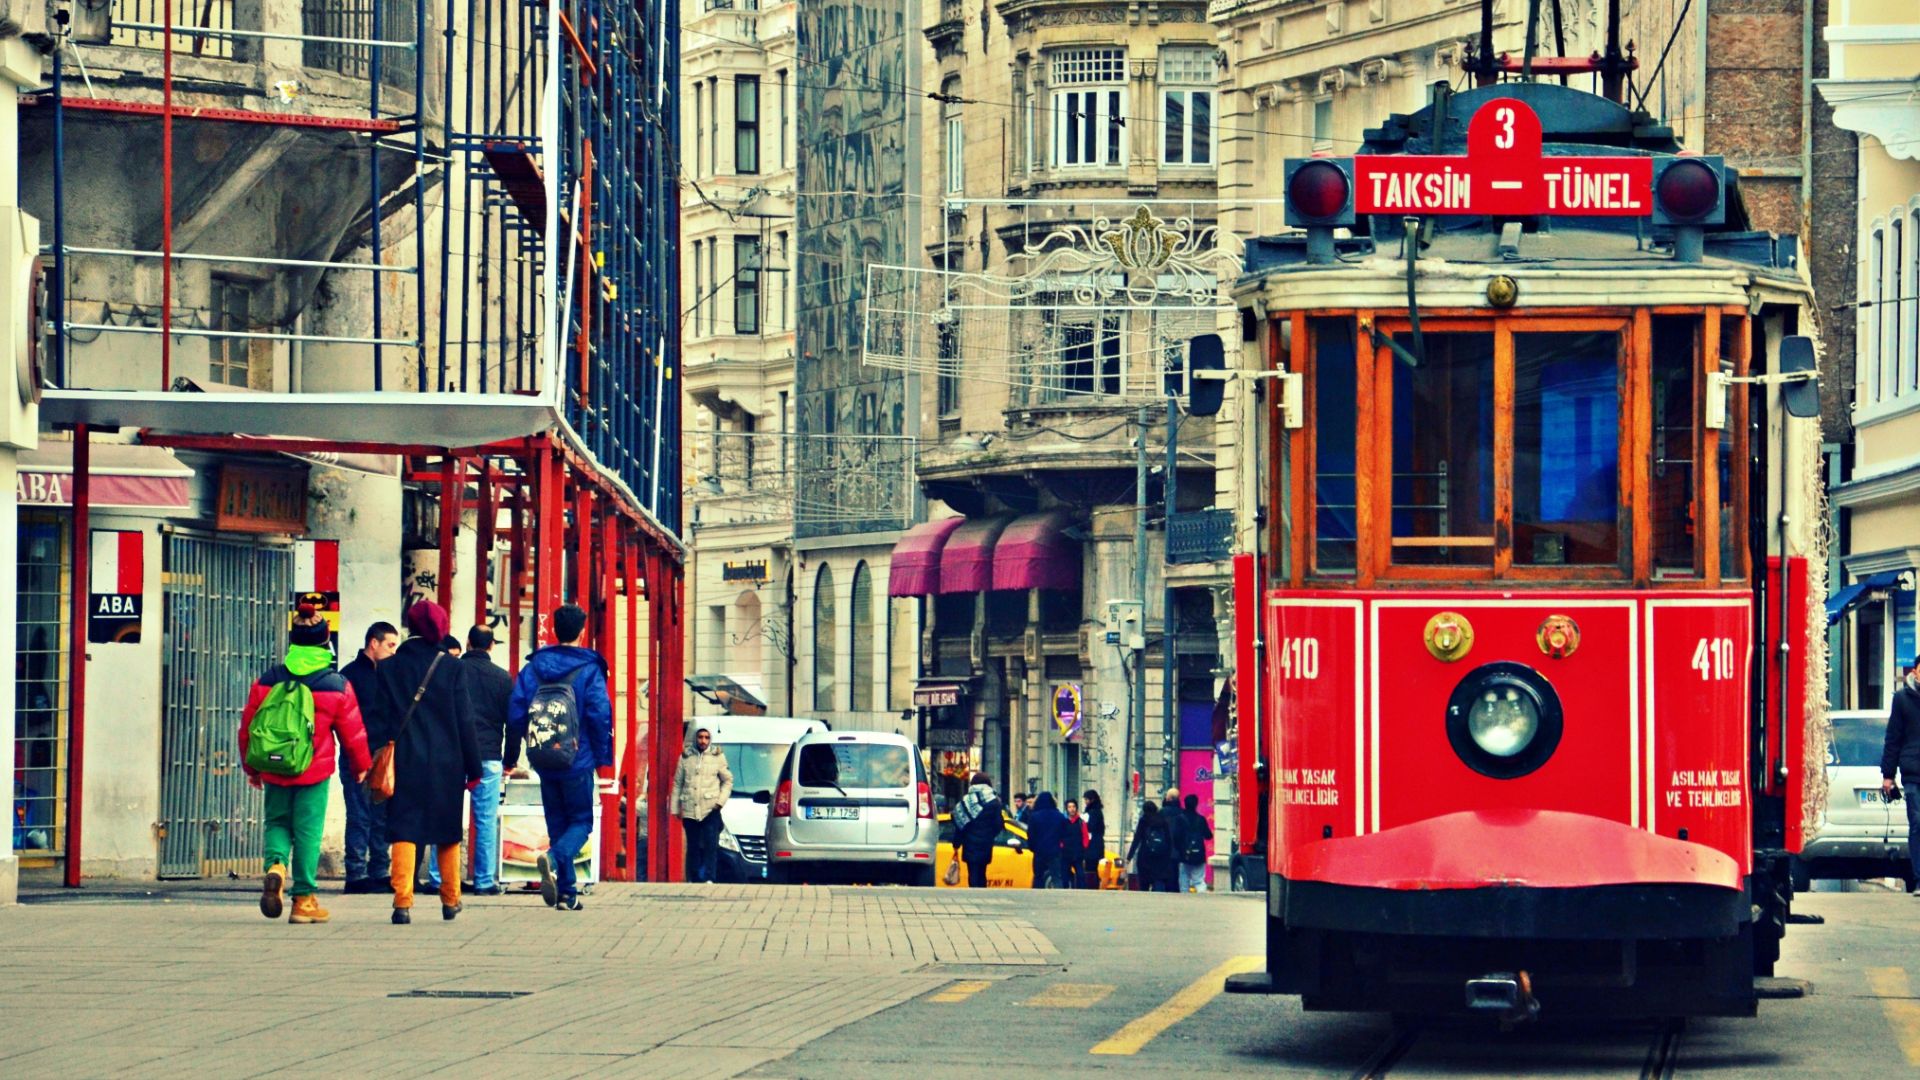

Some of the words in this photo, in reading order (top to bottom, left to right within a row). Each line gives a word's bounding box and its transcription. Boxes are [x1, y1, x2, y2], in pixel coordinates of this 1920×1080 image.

[1495, 107, 1515, 150] 3
[1368, 165, 1471, 209] TAKSİM
[1543, 166, 1641, 209] TÜNEL
[98, 595, 135, 614] ABA
[1280, 637, 1319, 680] 410
[1691, 637, 1735, 681] 410
[1301, 768, 1336, 785] YASAK
[1671, 770, 1718, 787] ASILMAK
[1665, 791, 1683, 808] VE
[1867, 792, 1878, 802] 06
[811, 807, 821, 816] 34
